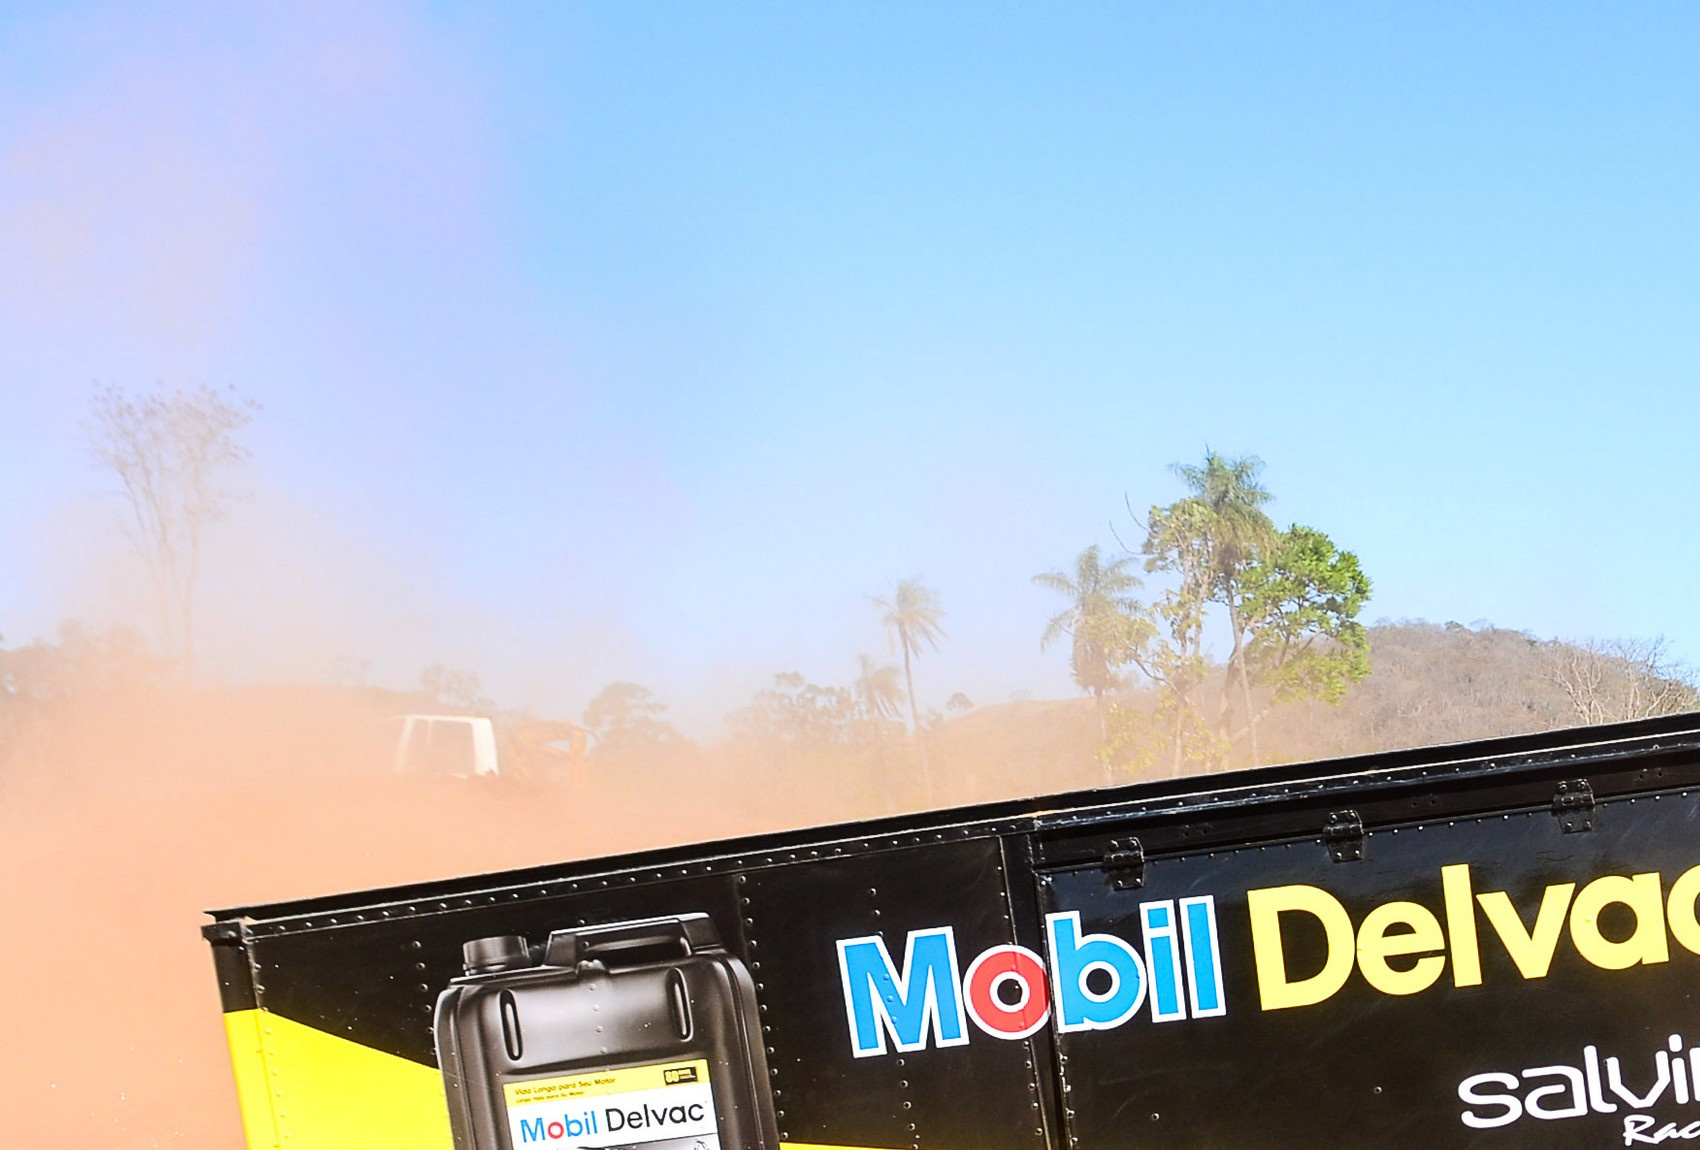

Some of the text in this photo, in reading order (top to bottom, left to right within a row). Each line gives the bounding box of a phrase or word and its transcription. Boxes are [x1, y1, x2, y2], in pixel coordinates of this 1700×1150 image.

[836, 895, 1227, 1059] Mobil
[519, 1103, 705, 1144] Mobil Delvac
